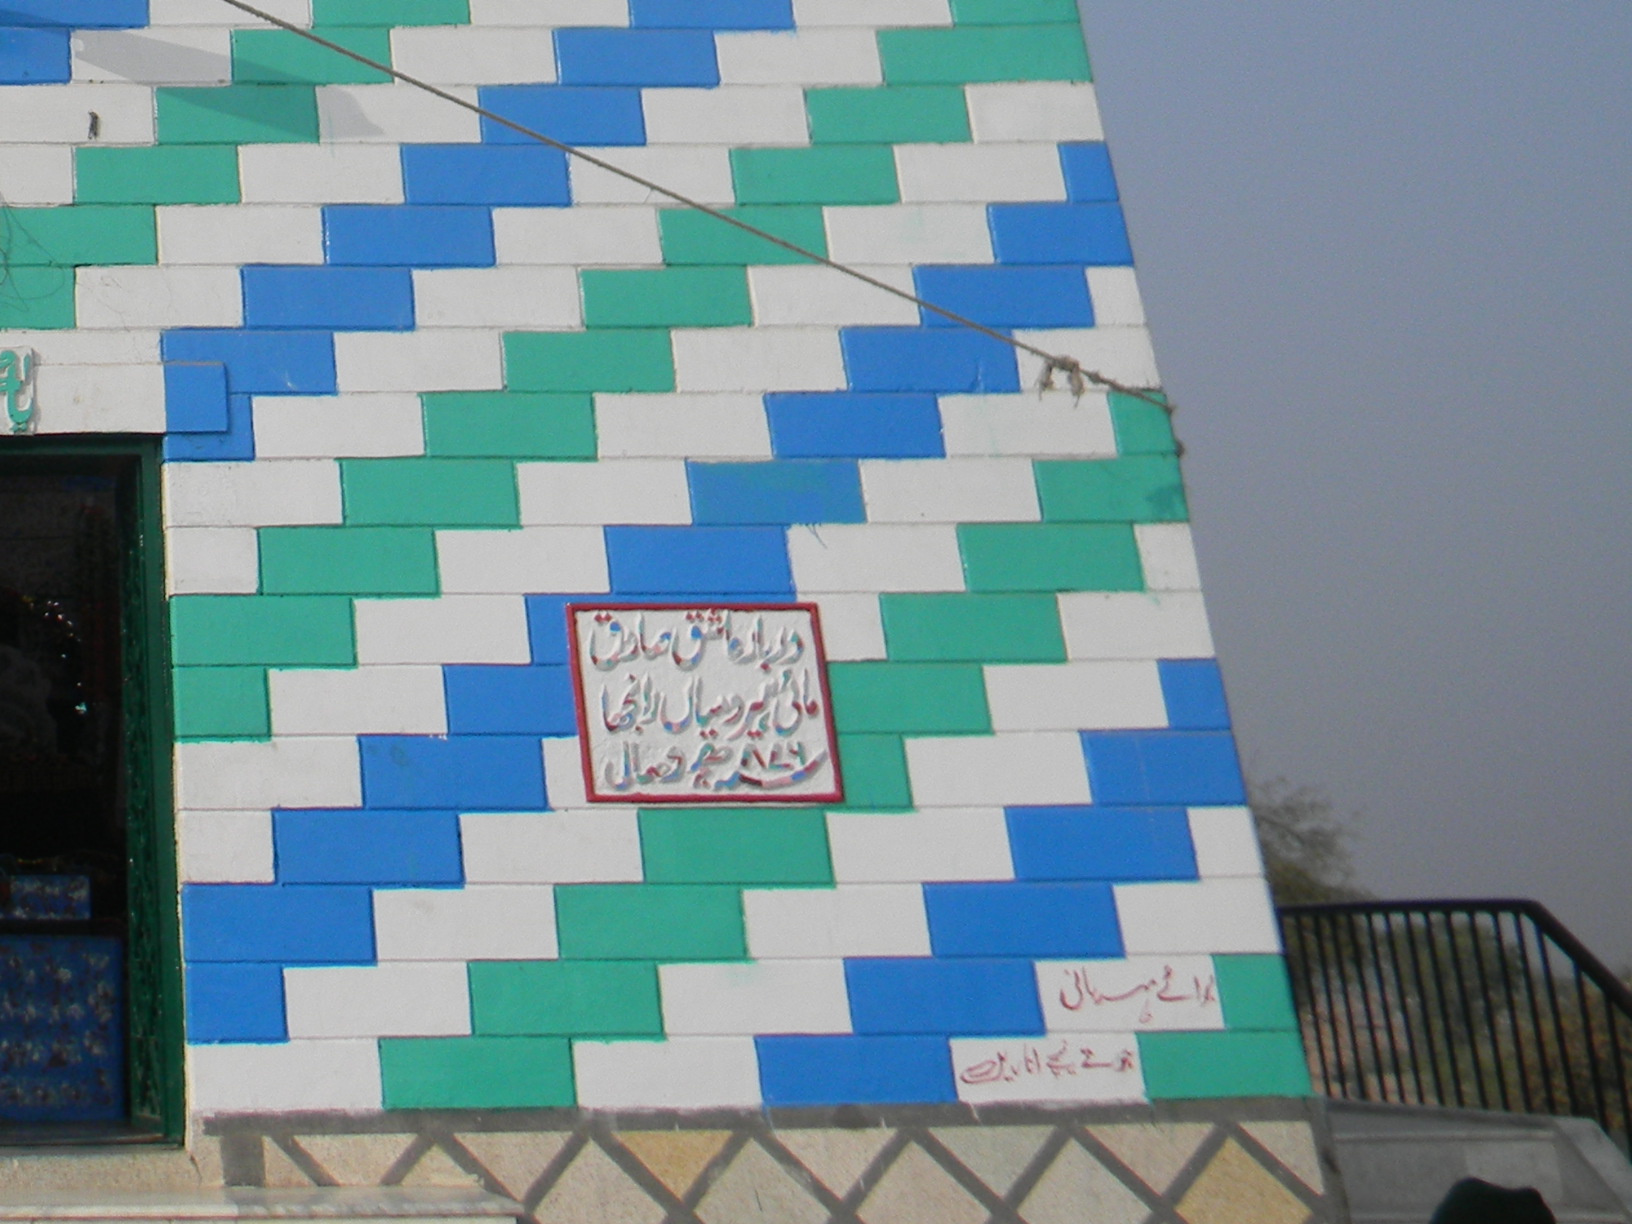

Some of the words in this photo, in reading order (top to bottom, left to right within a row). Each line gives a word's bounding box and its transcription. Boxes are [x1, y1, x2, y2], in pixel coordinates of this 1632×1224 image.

[589, 611, 671, 671] صادق
[671, 609, 745, 671] عاشق
[734, 614, 805, 671] دربار
[602, 673, 660, 734] رانجھا
[660, 677, 724, 739] میاں
[728, 677, 778, 740] ہیر
[772, 668, 818, 736] مائی
[1059, 967, 1159, 1024] مہربانی
[1157, 965, 1217, 1008] برائے
[960, 1044, 1039, 1084] اتاریں
[1046, 1039, 1077, 1077] نیچے
[1082, 1047, 1136, 1073] جوتے
